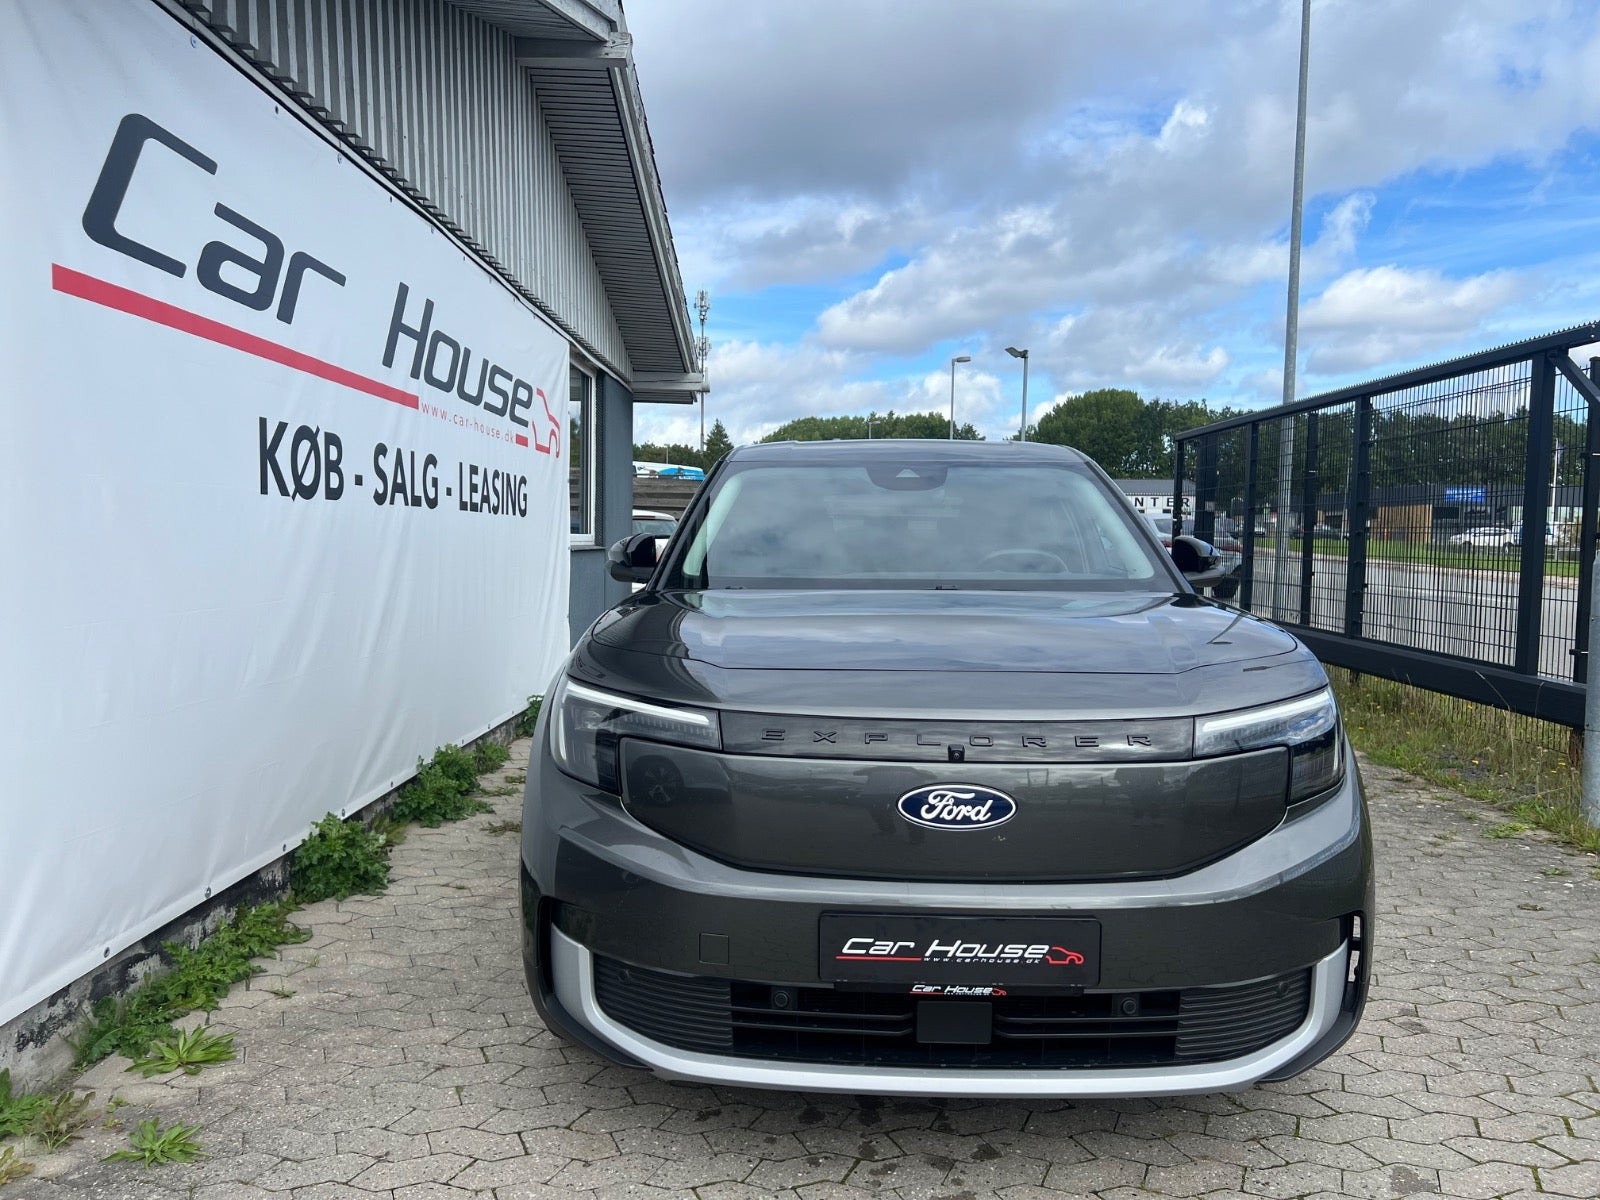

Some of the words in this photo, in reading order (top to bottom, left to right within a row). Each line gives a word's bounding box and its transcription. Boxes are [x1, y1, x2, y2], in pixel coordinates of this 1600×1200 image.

[82, 113, 346, 325] Car
[382, 281, 533, 428] House
[421, 402, 515, 443] www.car-house.dk
[258, 416, 344, 502] KØB
[373, 442, 439, 510] SALG
[459, 461, 528, 518] LEASING
[760, 728, 1152, 748] EXPLORER
[920, 790, 994, 821] Ford
[841, 937, 916, 955] Car
[925, 939, 1050, 959] House
[923, 957, 1041, 965] www.carhouse.dk
[912, 984, 942, 993] Car
[944, 985, 993, 994] House
